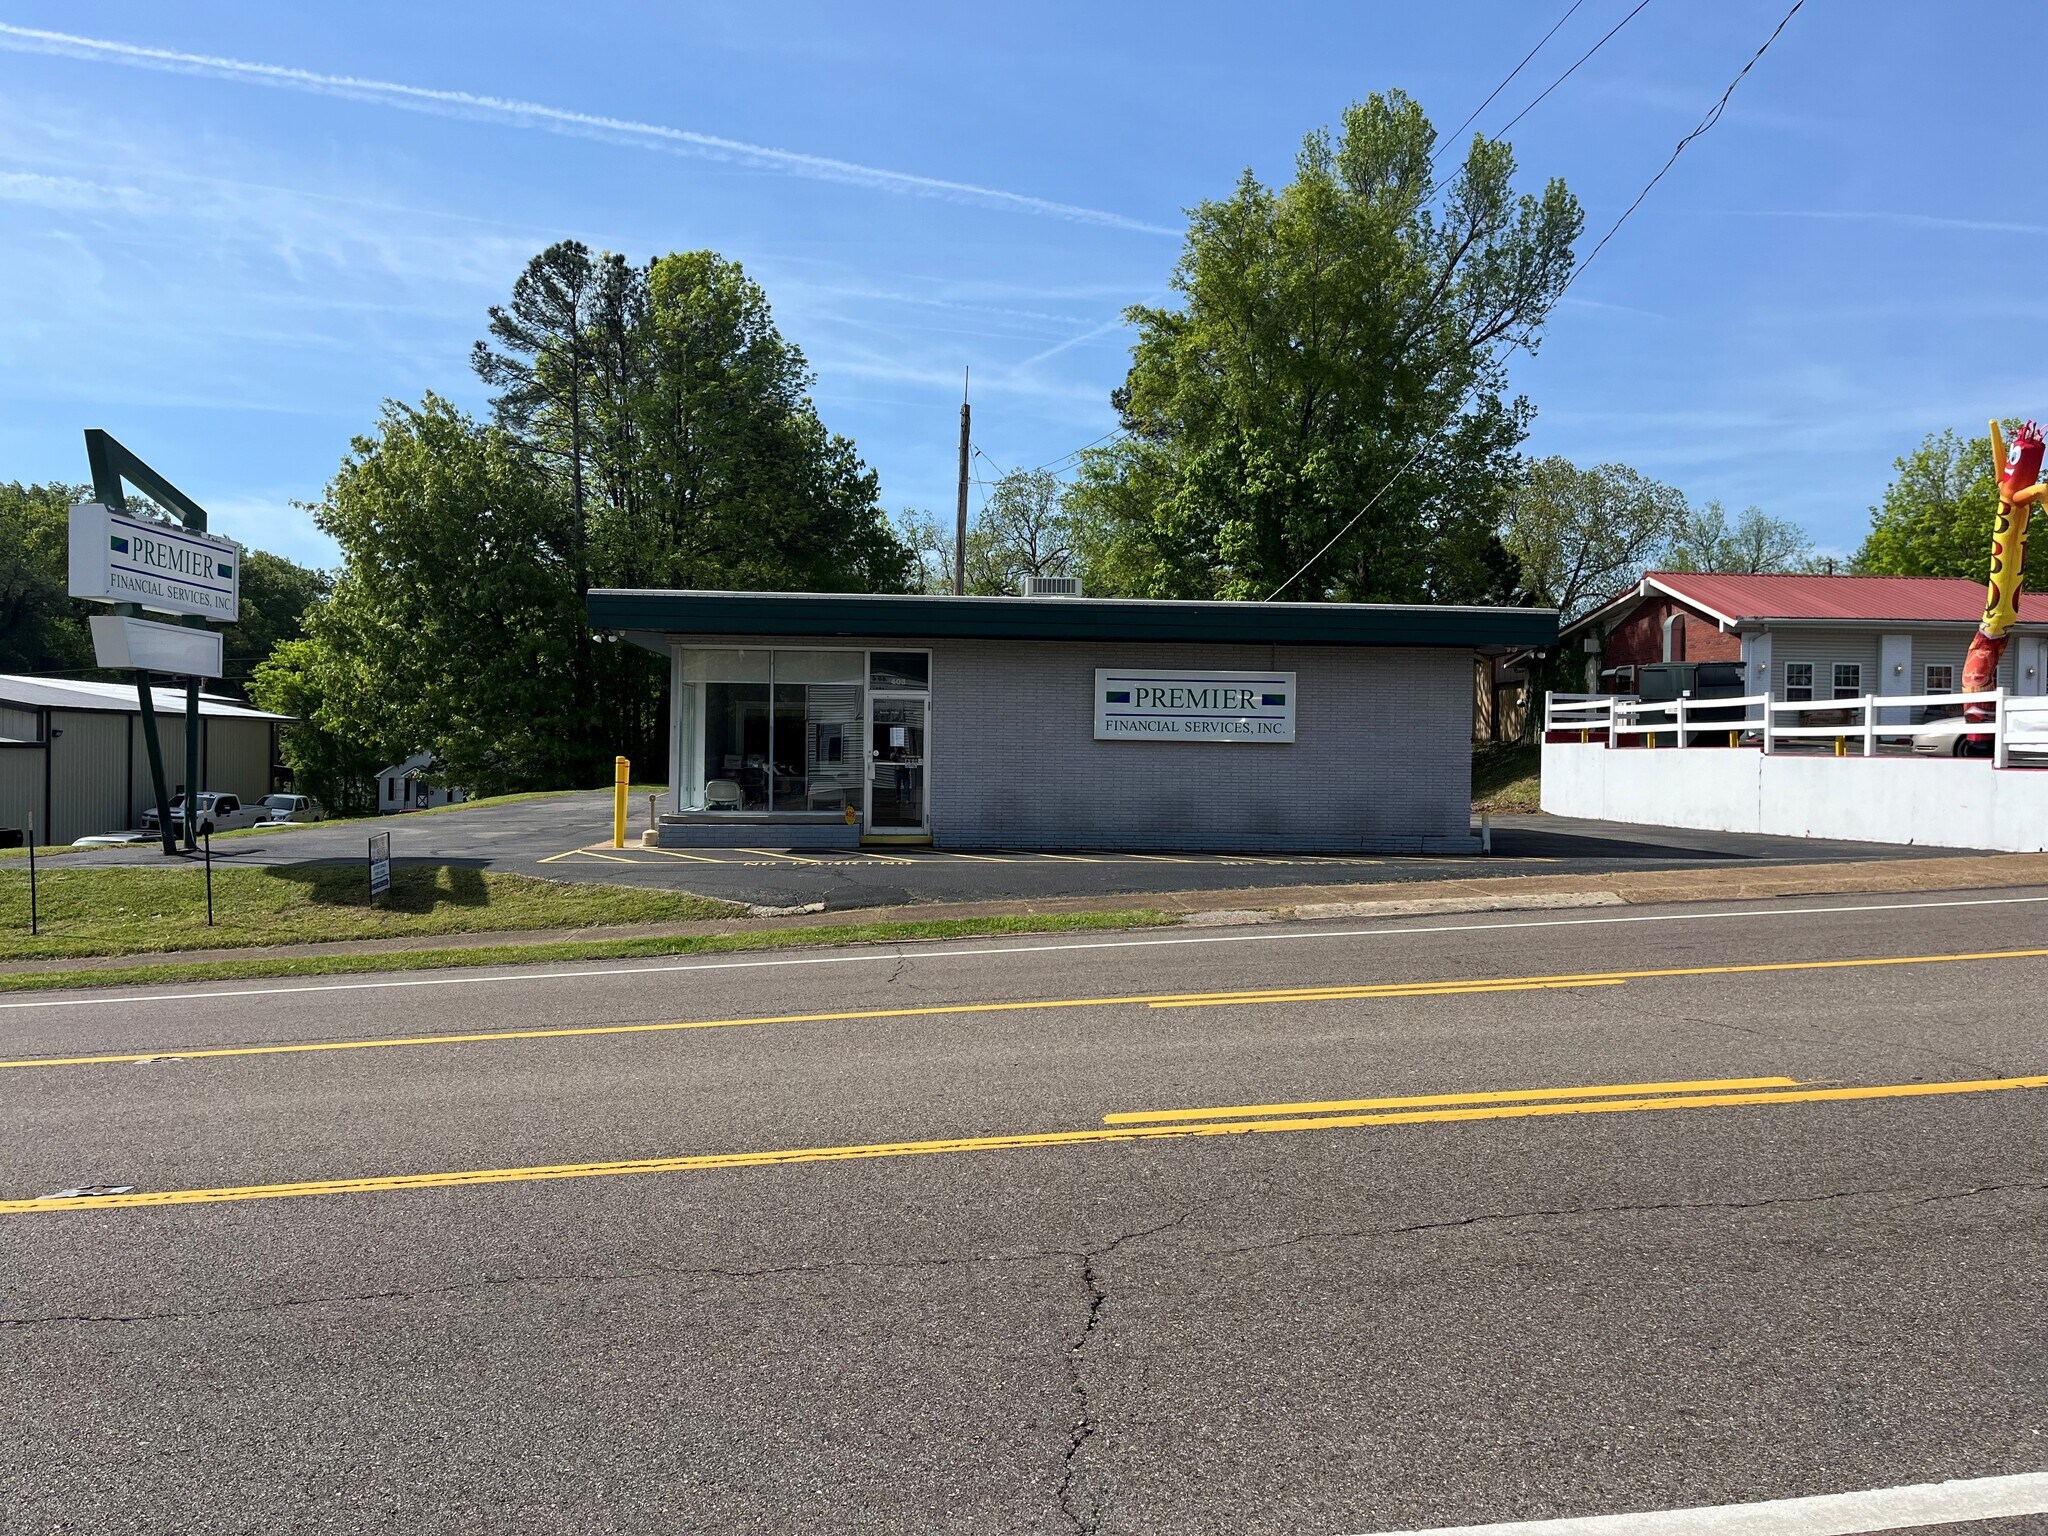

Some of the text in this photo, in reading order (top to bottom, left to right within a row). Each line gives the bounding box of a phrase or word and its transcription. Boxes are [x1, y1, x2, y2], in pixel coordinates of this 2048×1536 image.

[132, 537, 215, 579] PREMIER
[110, 573, 164, 596] FINANCIAL
[216, 595, 233, 611] INC.
[1134, 687, 1258, 710] PREMIER
[1105, 720, 1286, 735] FINANCIAL SERVICES, INC.
